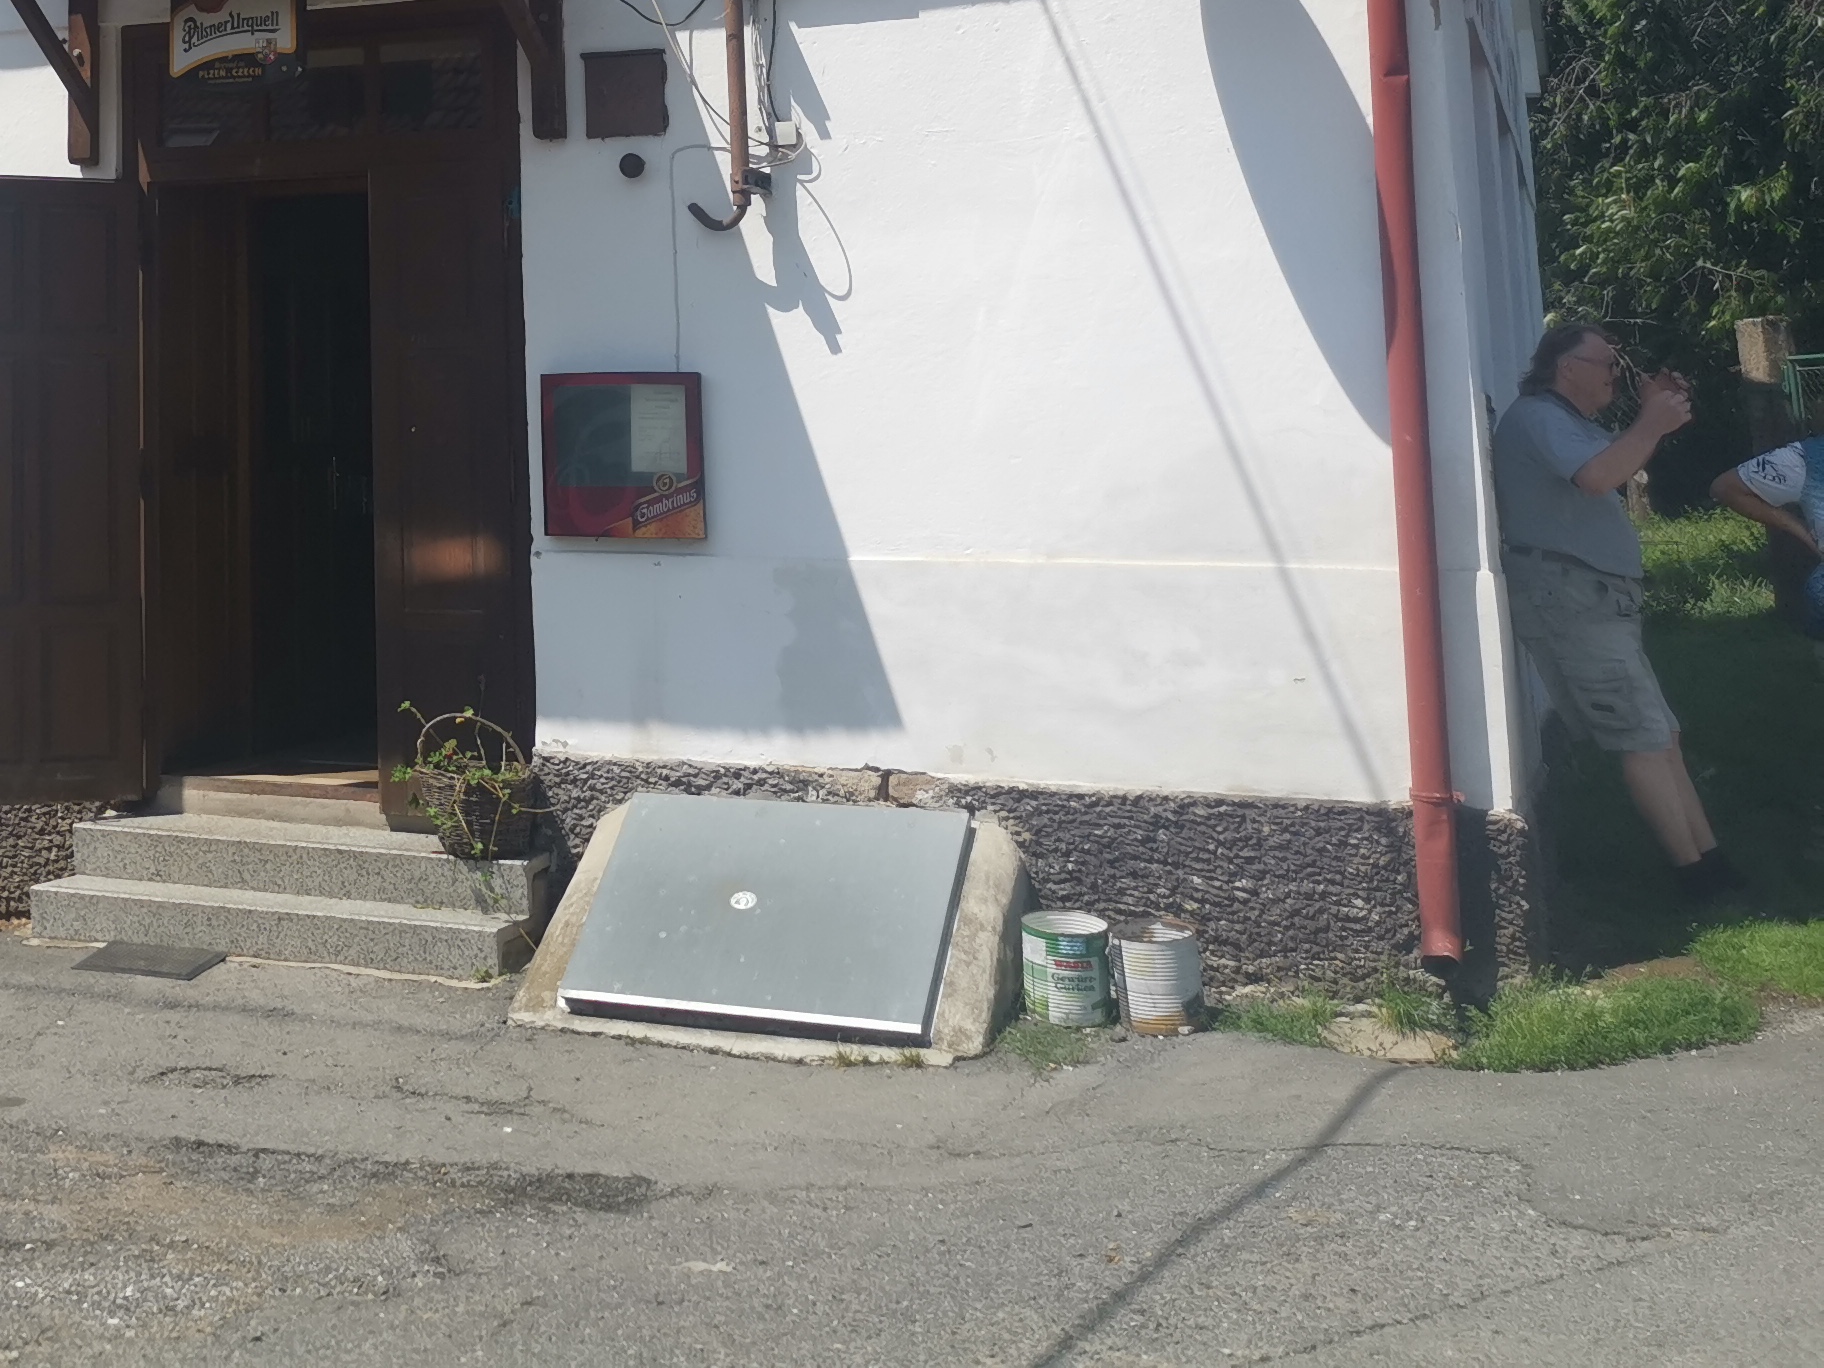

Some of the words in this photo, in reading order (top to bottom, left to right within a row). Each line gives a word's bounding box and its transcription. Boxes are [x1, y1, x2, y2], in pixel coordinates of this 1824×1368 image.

[182, 16, 231, 53] Pilsner
[229, 10, 280, 36] Urquell
[636, 489, 697, 522] Gambrinus
